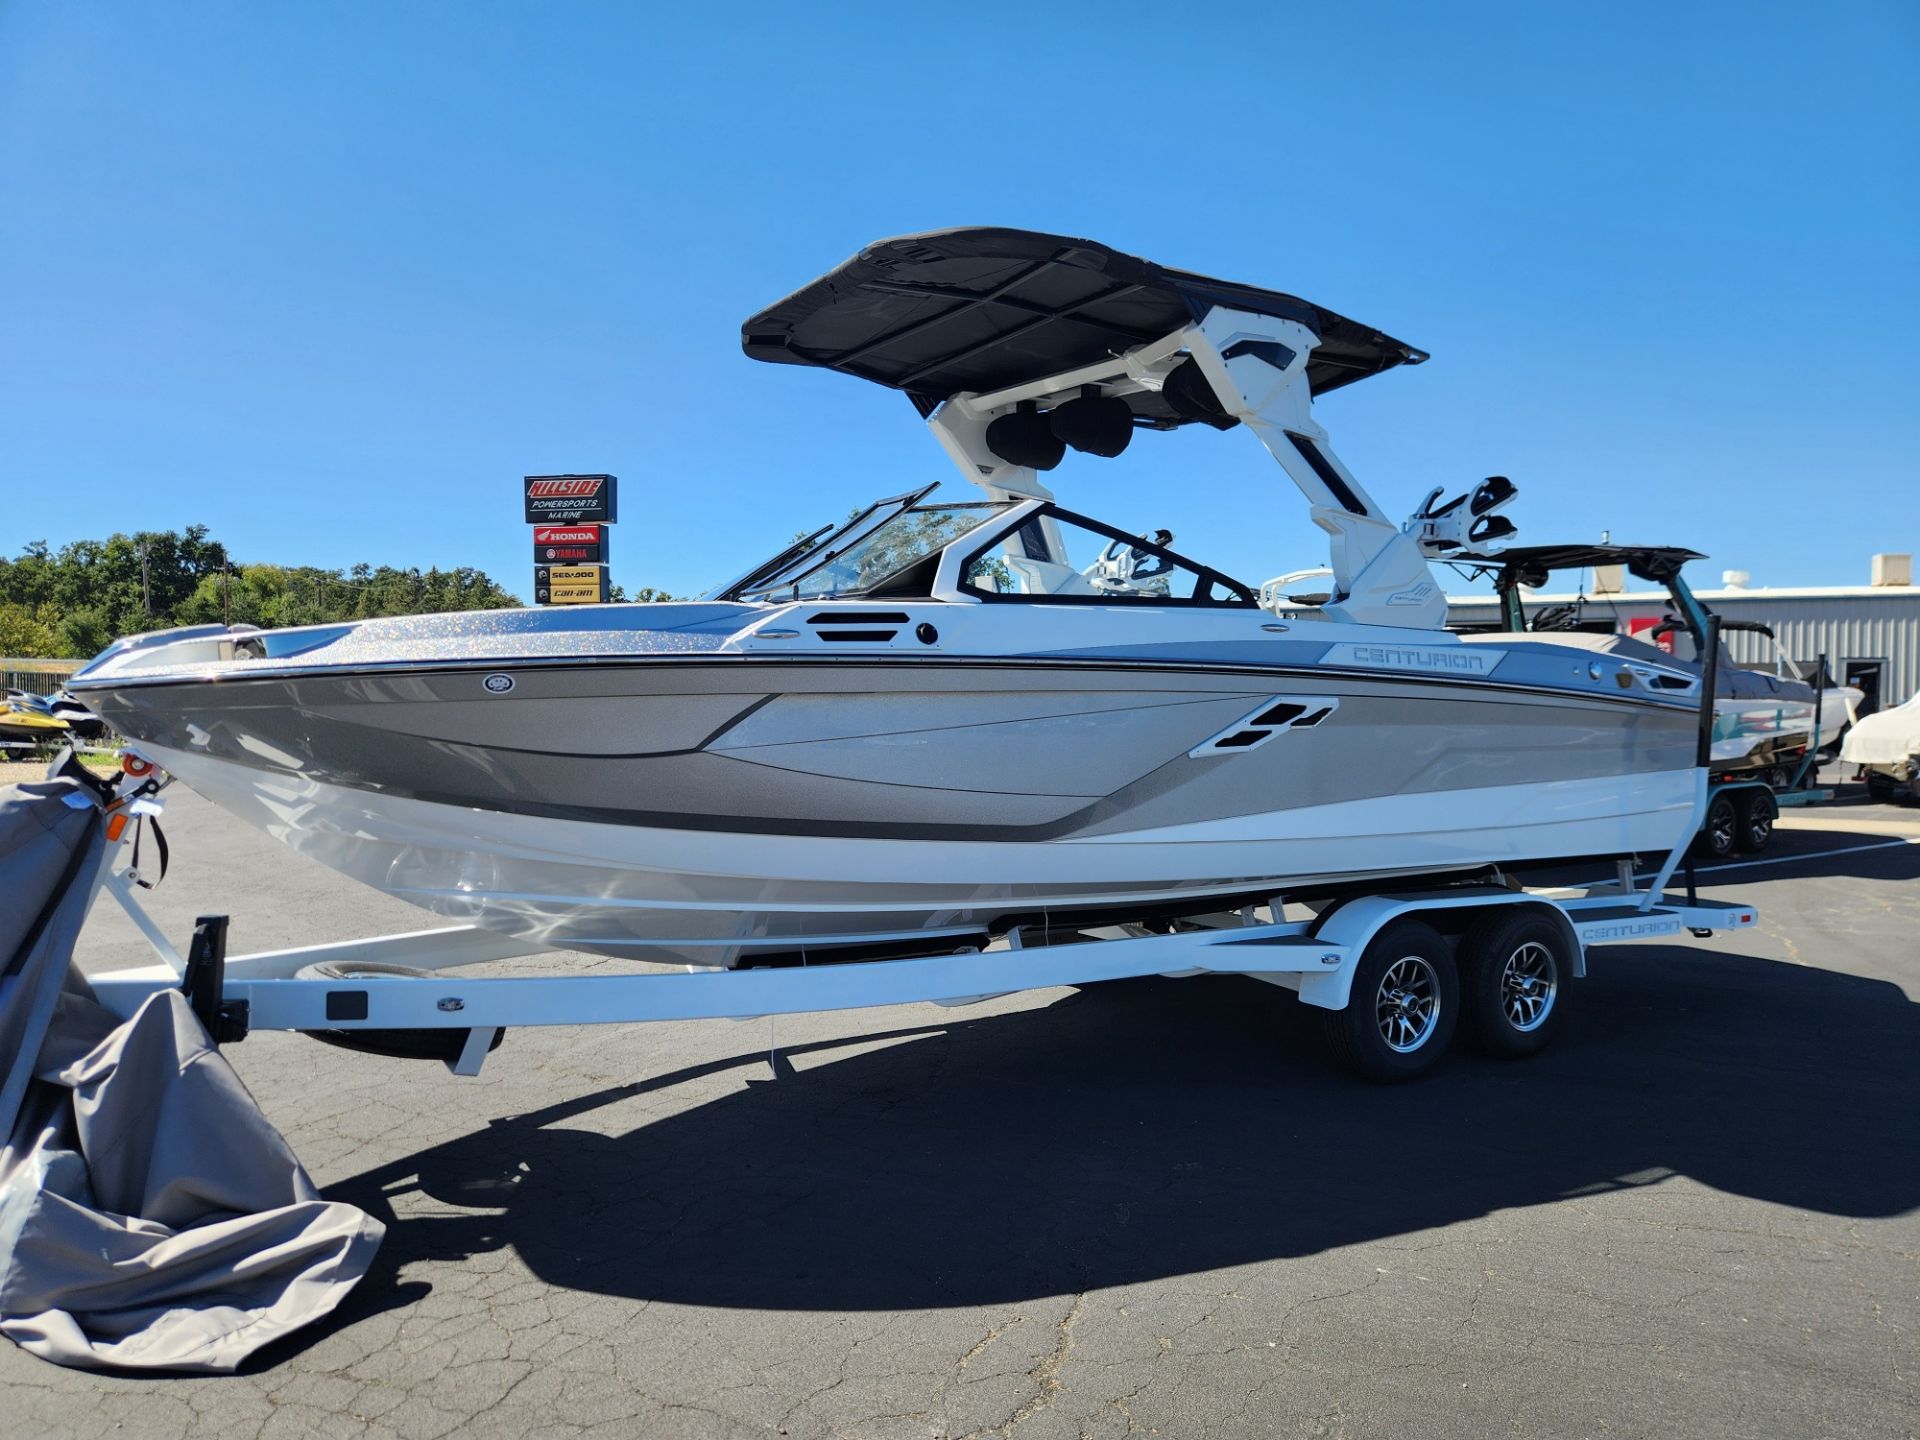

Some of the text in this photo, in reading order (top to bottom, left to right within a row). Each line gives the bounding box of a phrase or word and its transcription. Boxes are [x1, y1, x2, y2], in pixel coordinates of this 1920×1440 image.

[528, 480, 602, 498] HILLSIDE
[532, 500, 598, 509] POWERSPORTS
[548, 511, 582, 519] MARINE
[551, 532, 595, 541] HONDA
[556, 549, 587, 558] YAMAHA
[1353, 647, 1483, 670] CENTURION
[1583, 920, 1680, 939] CENTURION
